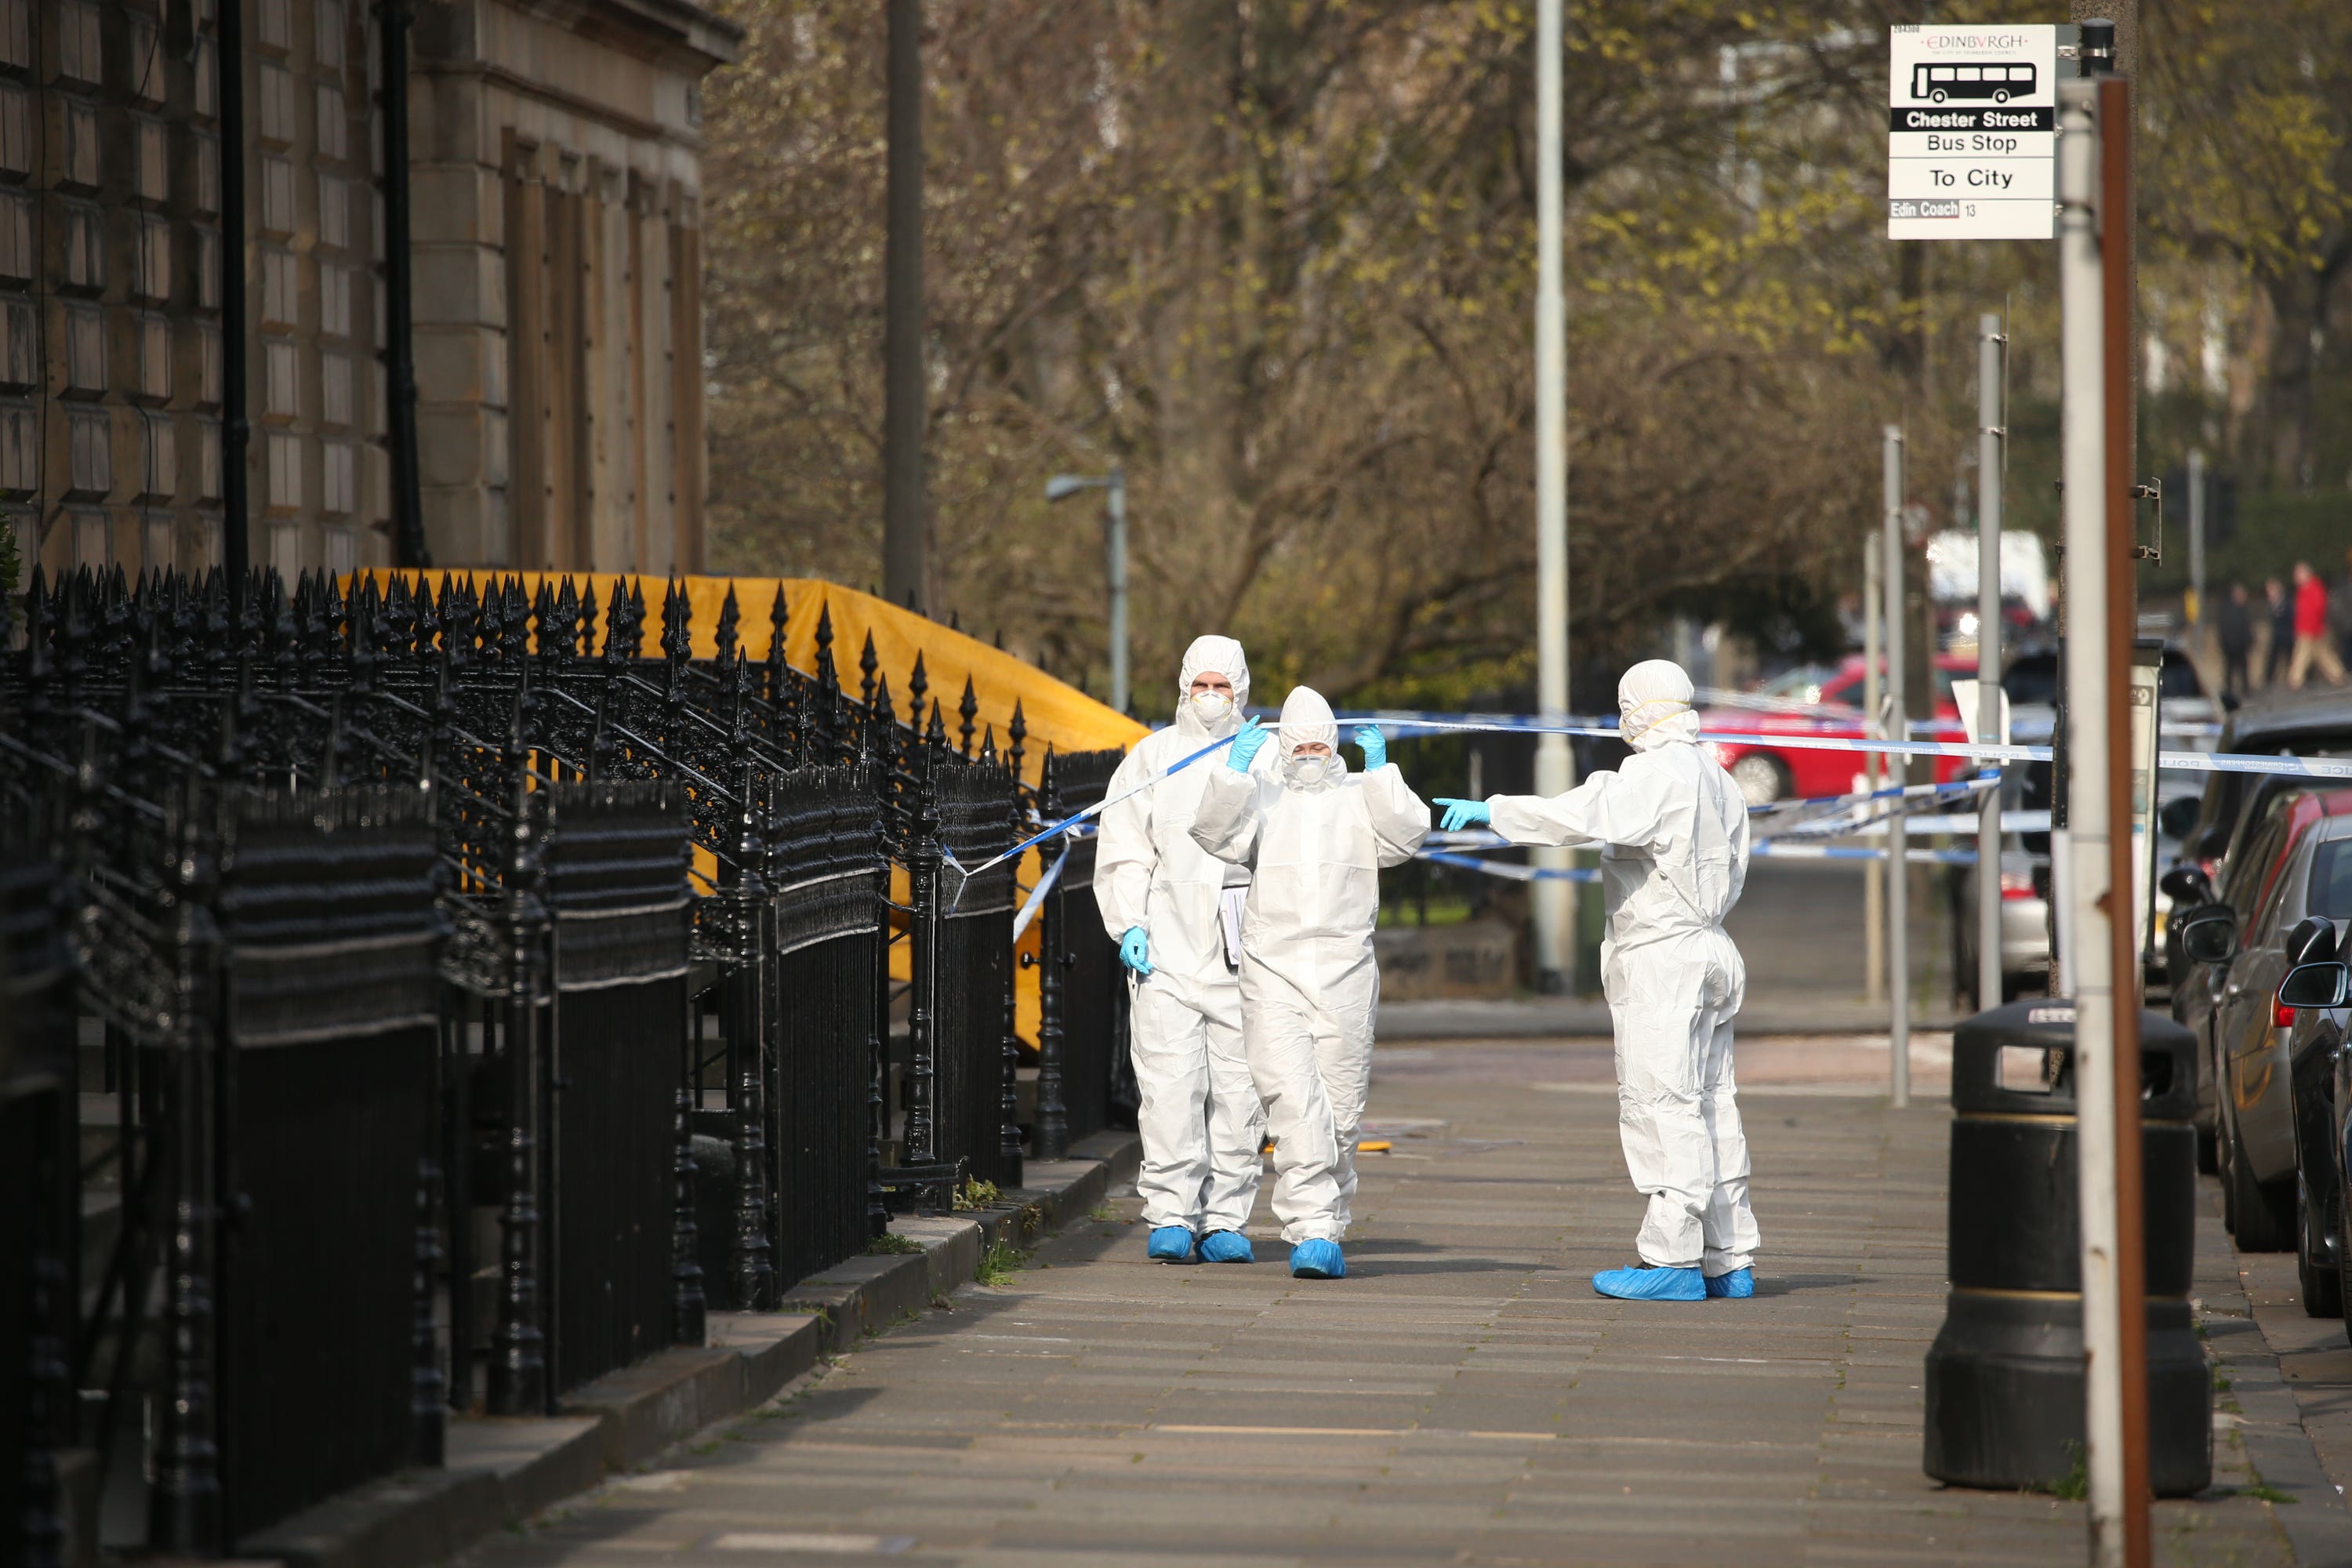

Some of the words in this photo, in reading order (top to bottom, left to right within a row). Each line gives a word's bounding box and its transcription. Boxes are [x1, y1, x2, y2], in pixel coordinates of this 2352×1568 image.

[1906, 111, 1976, 127] Chester
[1983, 111, 2038, 127] Street
[1928, 135, 1965, 151] Bus
[1972, 135, 2016, 154] Stop
[1929, 169, 1955, 186] To
[1968, 169, 2013, 189] City
[1890, 202, 1916, 216] Edin
[1921, 201, 1958, 216] Coach
[1965, 205, 1976, 217] 13
